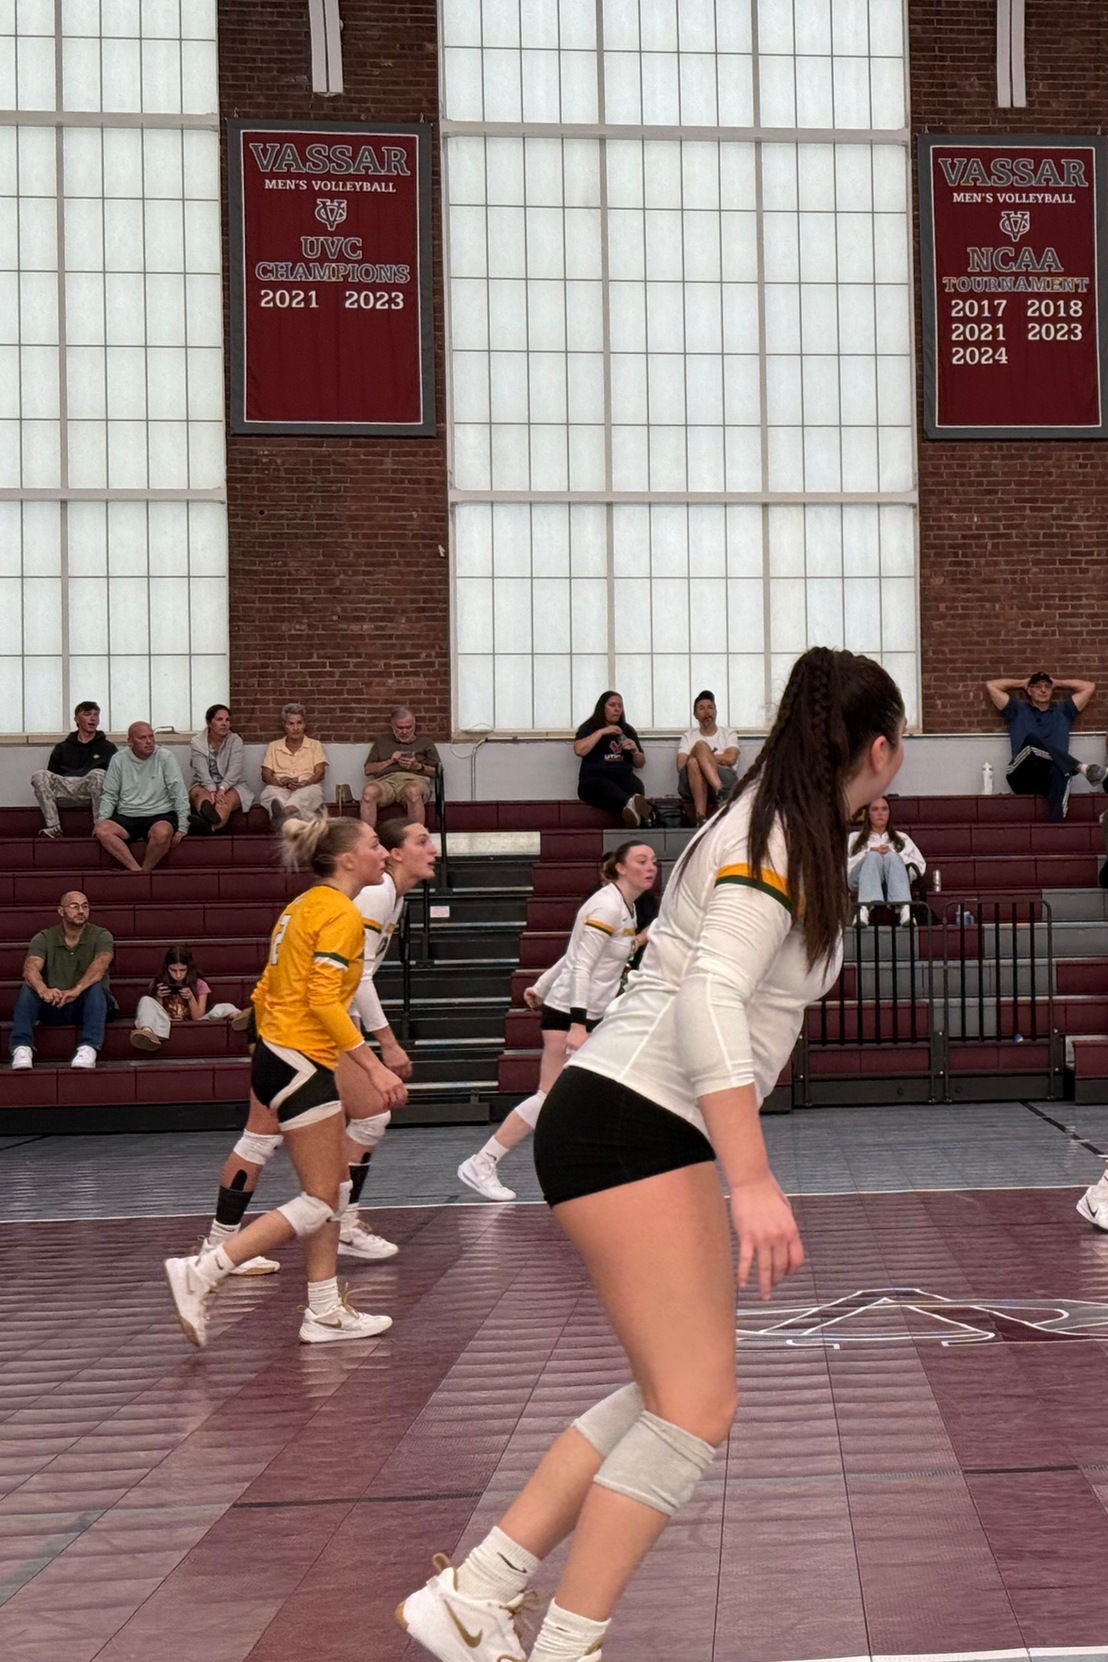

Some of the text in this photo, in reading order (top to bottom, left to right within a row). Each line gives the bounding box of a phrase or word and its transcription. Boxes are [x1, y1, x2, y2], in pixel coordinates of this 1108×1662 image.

[249, 143, 411, 176] VASSAR
[938, 157, 1089, 187] VASSAR
[264, 179, 397, 193] MEN'S VOLLEYBALL
[952, 192, 1076, 204] MEN'S VOLLEYBALL
[301, 236, 363, 260] UVC
[967, 247, 1064, 272] NCAA
[255, 262, 411, 284] CHAMPIONS
[943, 276, 1090, 293] TOURNAMENT
[260, 290, 405, 310] 2021 2023
[951, 300, 1083, 318] 2017 2018
[951, 323, 1083, 341] 2021 2023
[951, 347, 1008, 365] 2024
